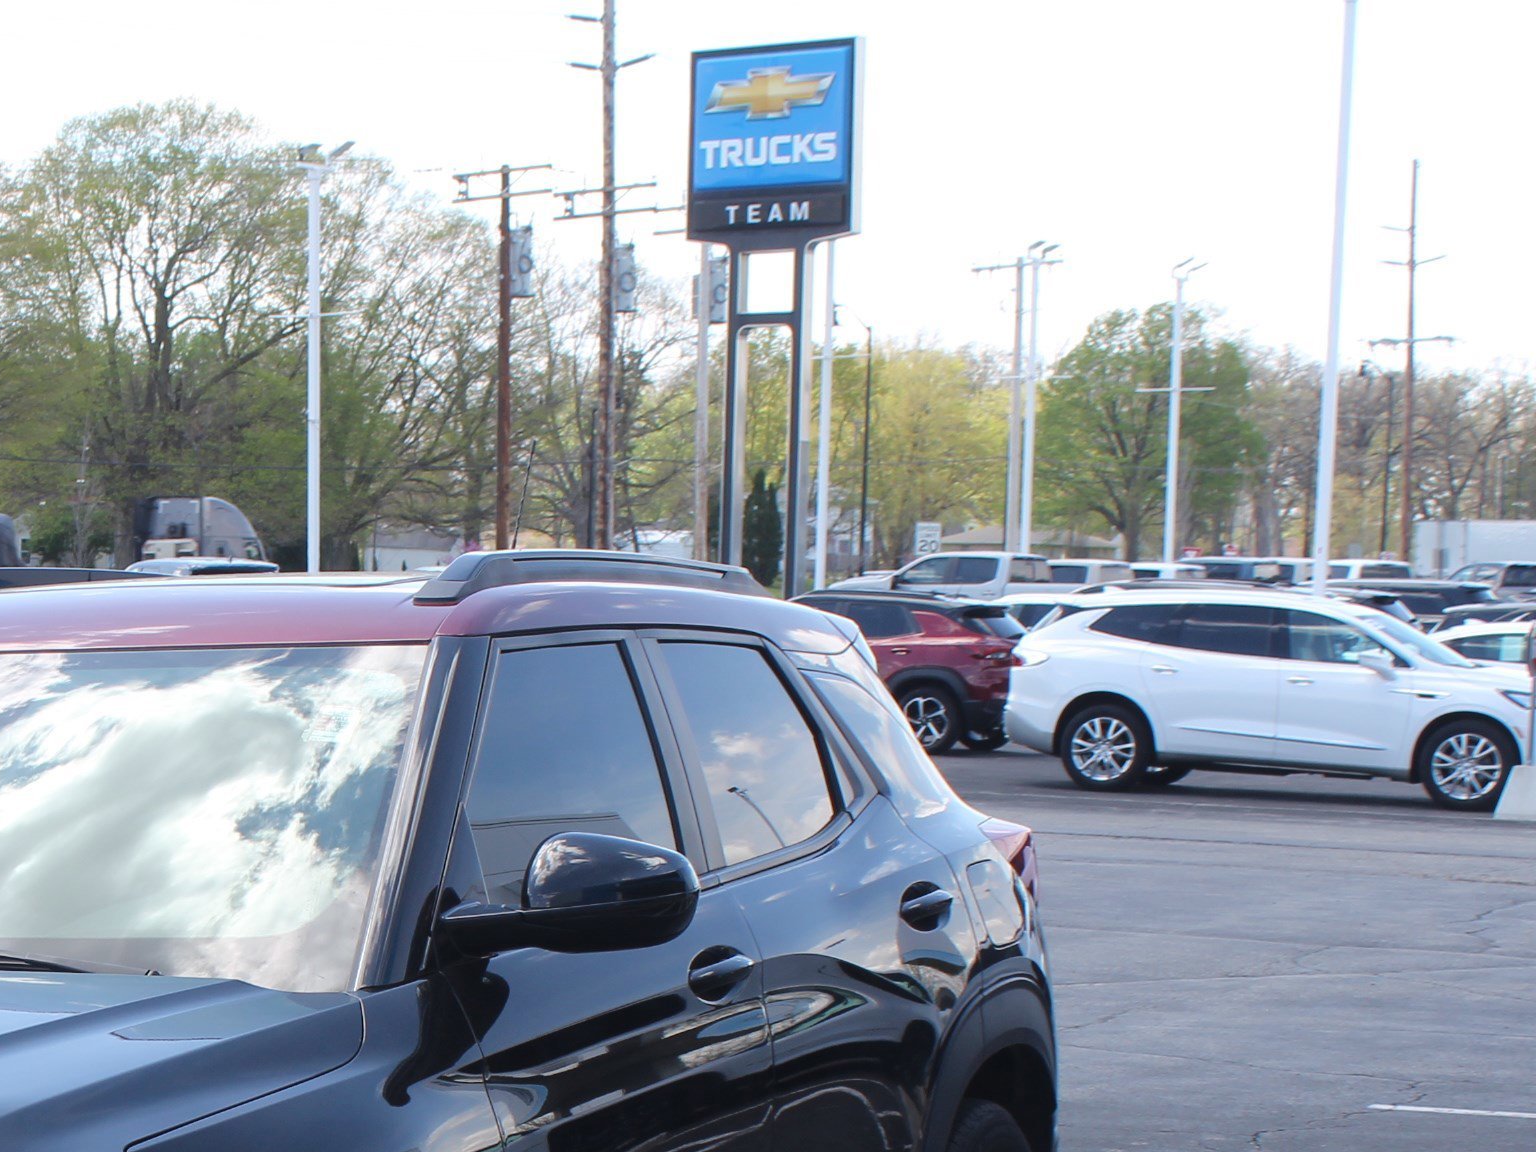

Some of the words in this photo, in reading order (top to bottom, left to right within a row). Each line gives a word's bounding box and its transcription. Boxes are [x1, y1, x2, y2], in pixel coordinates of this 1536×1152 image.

[699, 131, 838, 170] TRUCKS
[725, 201, 810, 225] TEAM
[918, 539, 940, 553] 20
